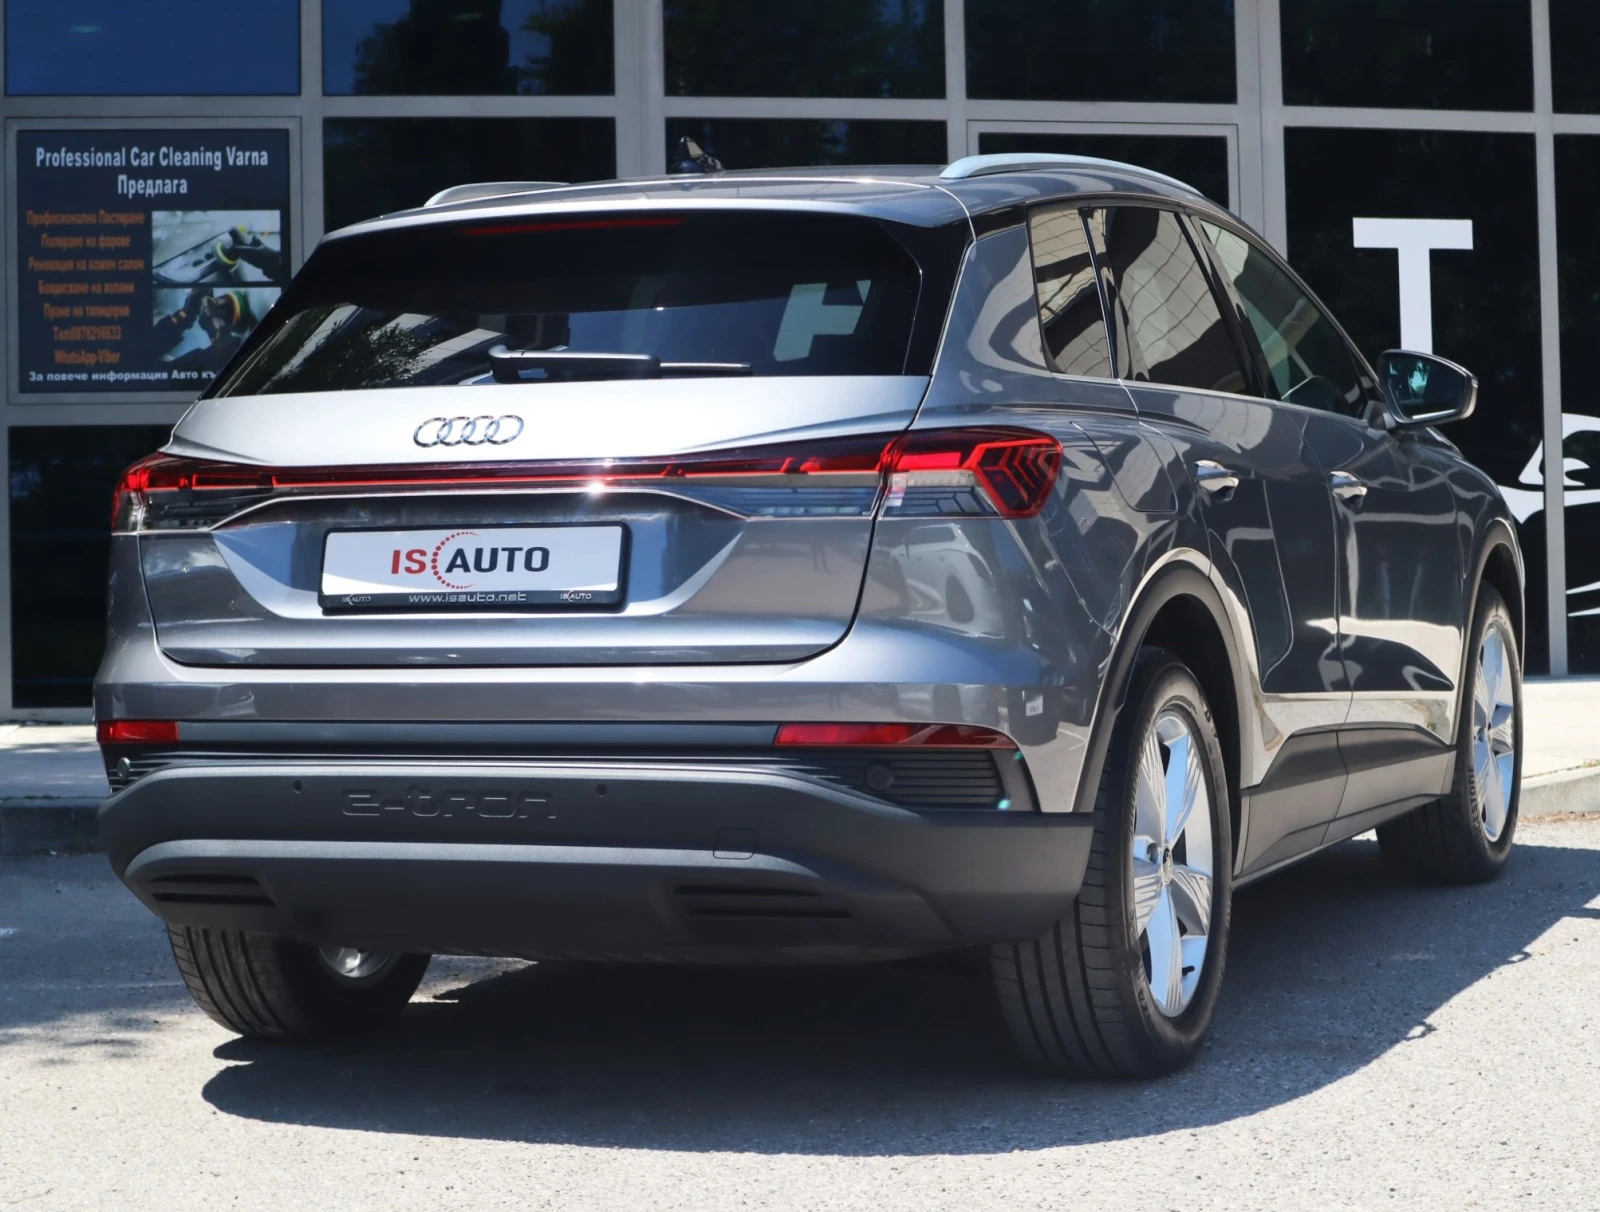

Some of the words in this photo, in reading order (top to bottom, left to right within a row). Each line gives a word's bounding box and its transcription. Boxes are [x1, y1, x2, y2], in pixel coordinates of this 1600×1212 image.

[35, 147, 126, 167] Professional
[130, 147, 155, 167] Car
[159, 147, 222, 171] Cleaning
[226, 146, 268, 166] Varna
[118, 174, 188, 199] Предлага
[1353, 217, 1473, 355] T
[29, 371, 43, 382] За
[47, 371, 88, 382] повече
[92, 370, 168, 383] информация
[171, 369, 199, 380] Авто
[391, 548, 427, 575] IS
[445, 546, 550, 573] AUTO
[408, 591, 527, 604] www.isauto.net
[341, 785, 557, 820] e-tron
